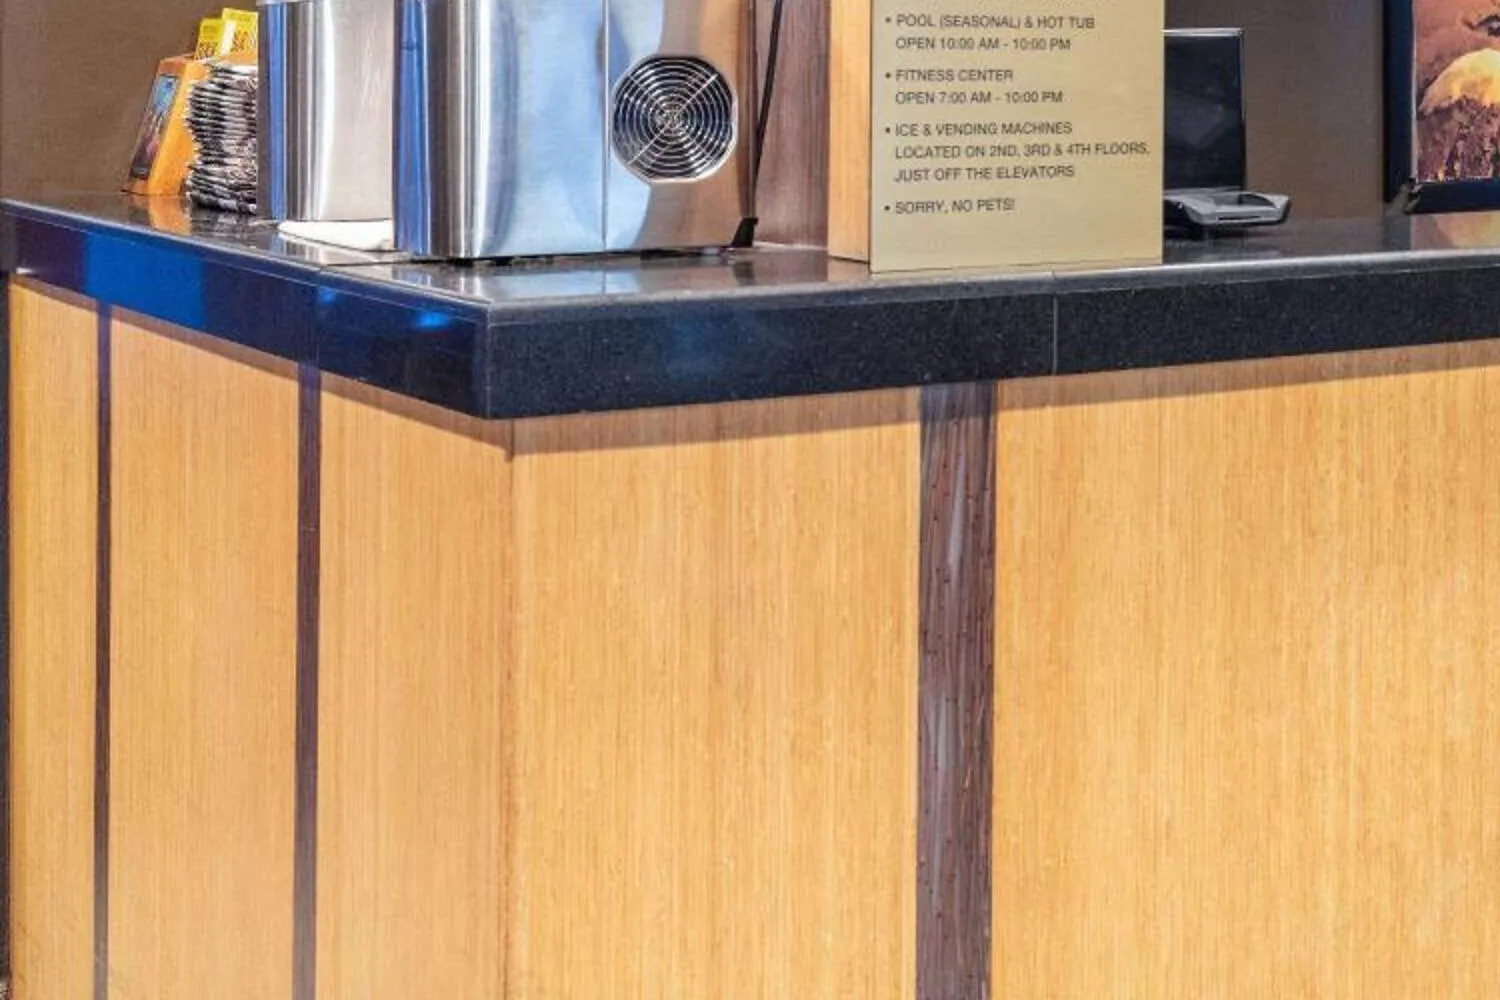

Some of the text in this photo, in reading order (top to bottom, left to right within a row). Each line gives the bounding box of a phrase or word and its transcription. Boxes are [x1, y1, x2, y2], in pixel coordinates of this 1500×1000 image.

[896, 14, 1095, 30] POOL (SEASONAL) & HOT TUB
[896, 37, 935, 50] OPEN
[940, 37, 974, 50] 10:00
[978, 38, 999, 50] AM
[1013, 38, 1047, 50] 10:00
[1050, 38, 1070, 50] PM
[896, 69, 1013, 82] FITNESS CENTER
[896, 92, 934, 104] OPEN
[939, 92, 967, 104] 7:00
[970, 92, 991, 104] AM
[1005, 92, 1039, 104] 10:00
[1042, 91, 1063, 103] PM
[896, 122, 1072, 136] ICE & VENDING MACHINES
[896, 146, 961, 160] LOCATED
[966, 146, 984, 158] ON
[990, 145, 1020, 159] 2ND,
[1024, 144, 1050, 157] 3RD
[1054, 144, 1062, 156] &
[1066, 143, 1090, 155] 4TH
[894, 166, 1075, 183] JUST OFF THE ELEVATORS
[896, 198, 1015, 214] SORRY, NO PETS!
